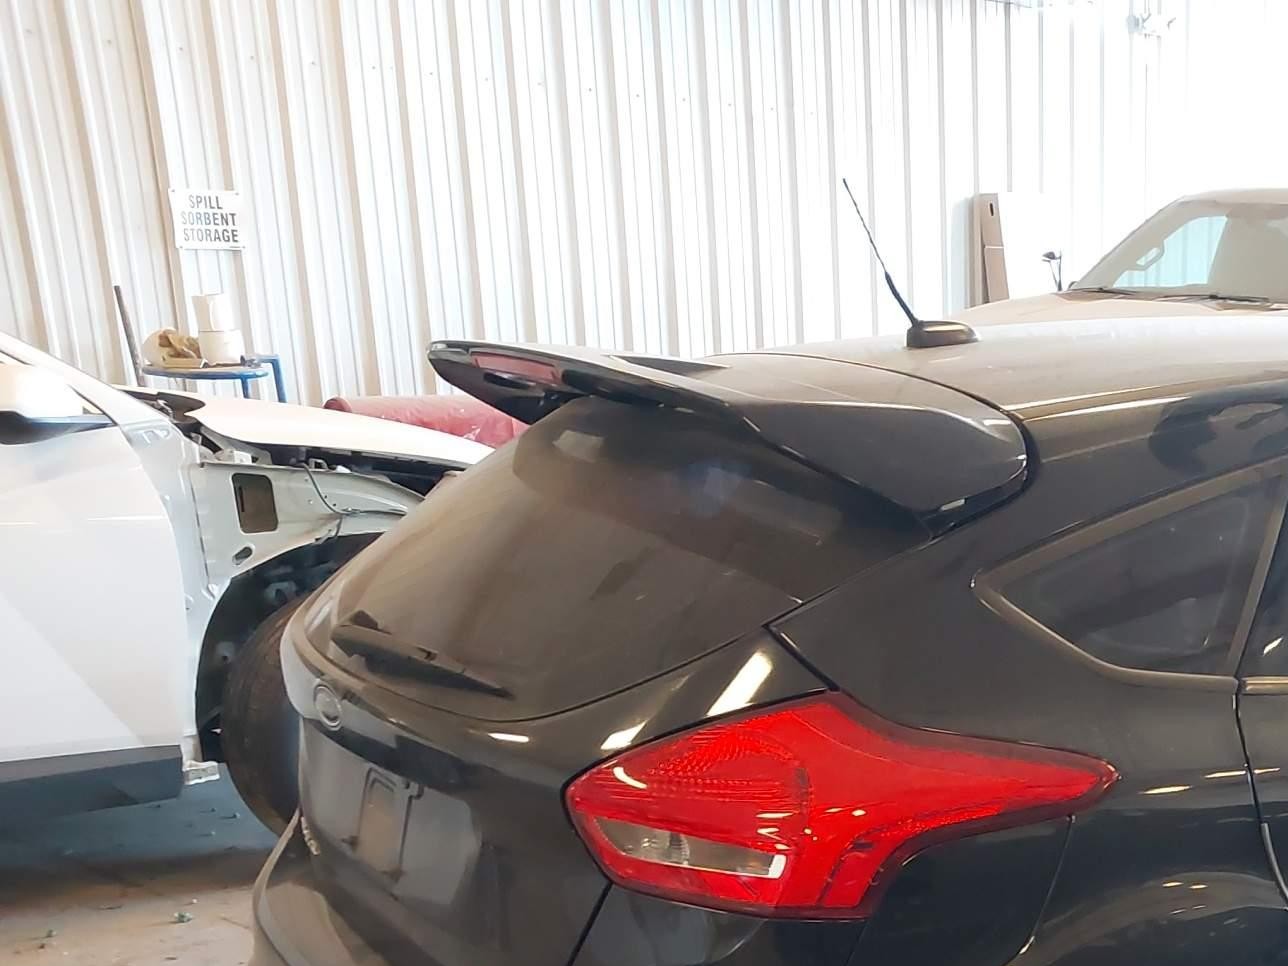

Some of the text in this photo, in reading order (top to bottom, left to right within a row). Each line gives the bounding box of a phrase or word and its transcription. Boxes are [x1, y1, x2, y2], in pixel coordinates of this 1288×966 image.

[188, 194, 223, 210] SPILL
[180, 211, 237, 226] SORBENT
[183, 228, 239, 243] STORAGE
